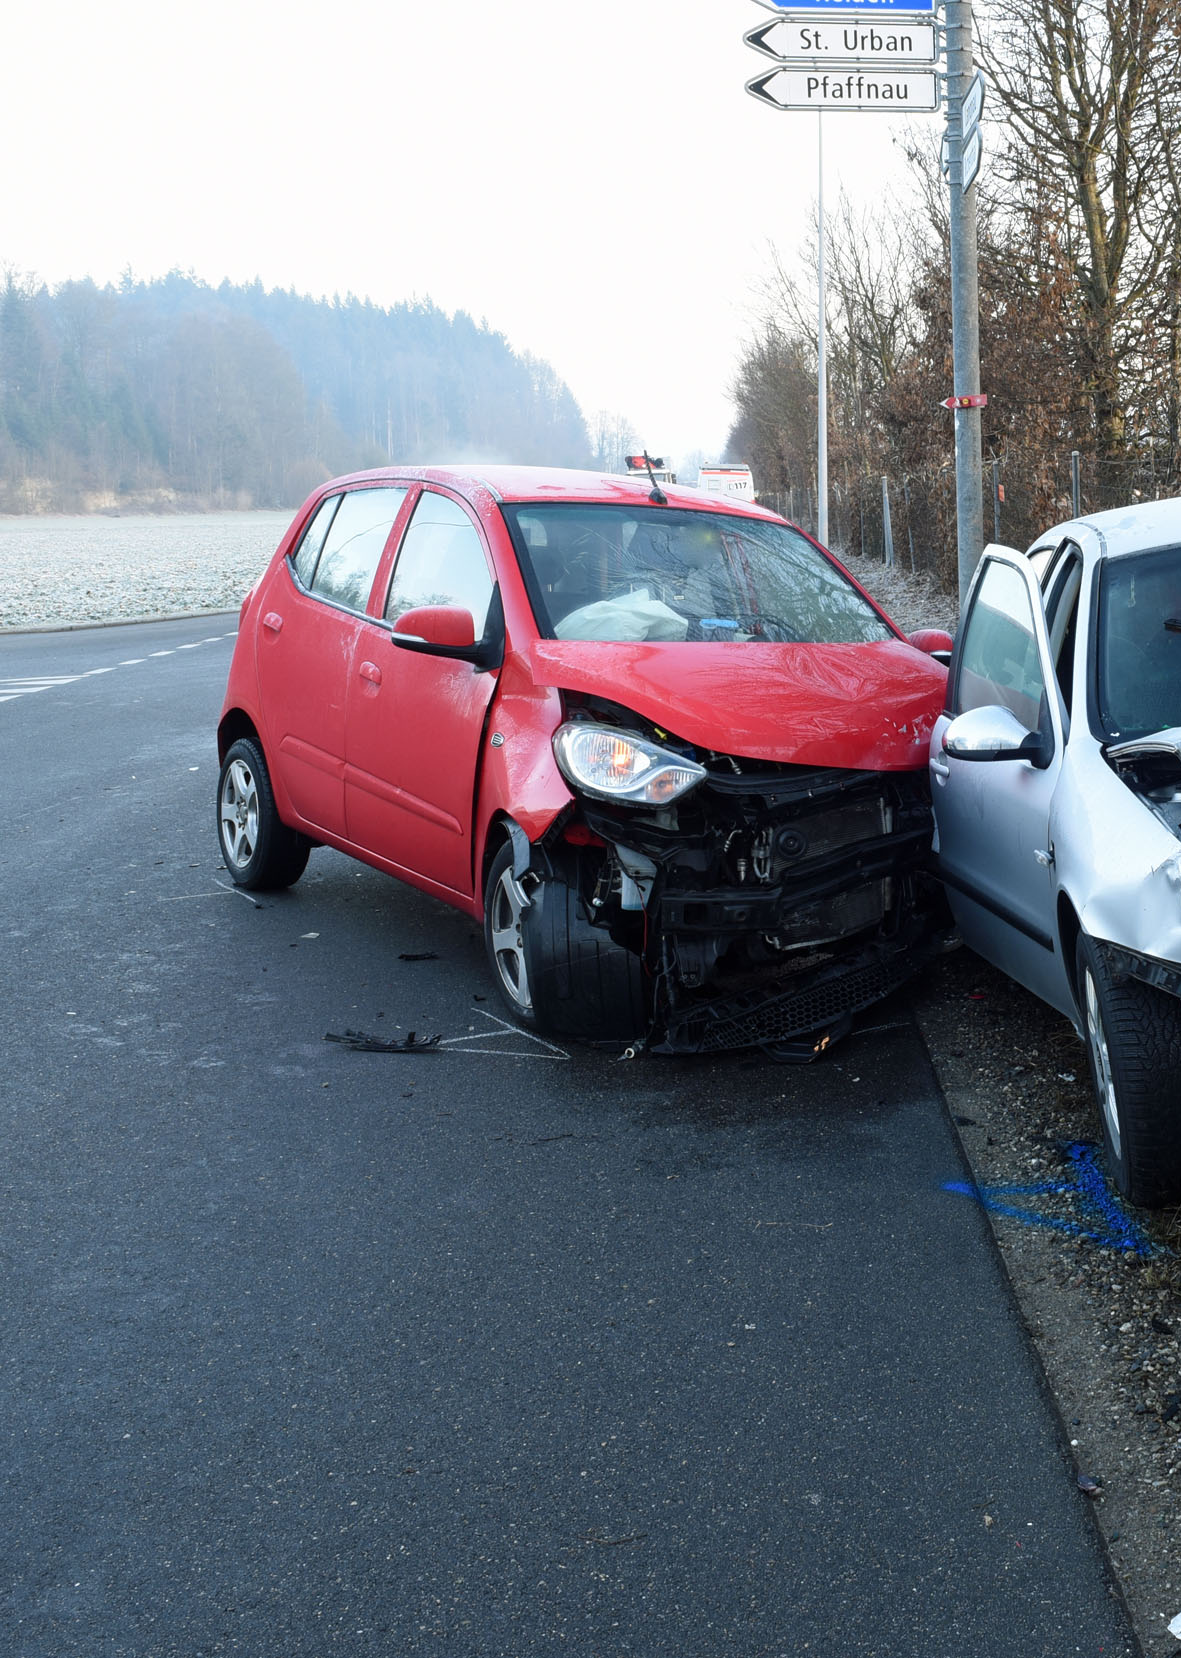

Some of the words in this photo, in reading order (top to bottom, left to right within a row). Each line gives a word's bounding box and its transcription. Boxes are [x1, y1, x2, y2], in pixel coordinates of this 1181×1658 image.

[800, 28, 829, 50] St.
[843, 29, 913, 52] Urban
[807, 76, 908, 99] Pfaffnau
[734, 482, 747, 490] 117
